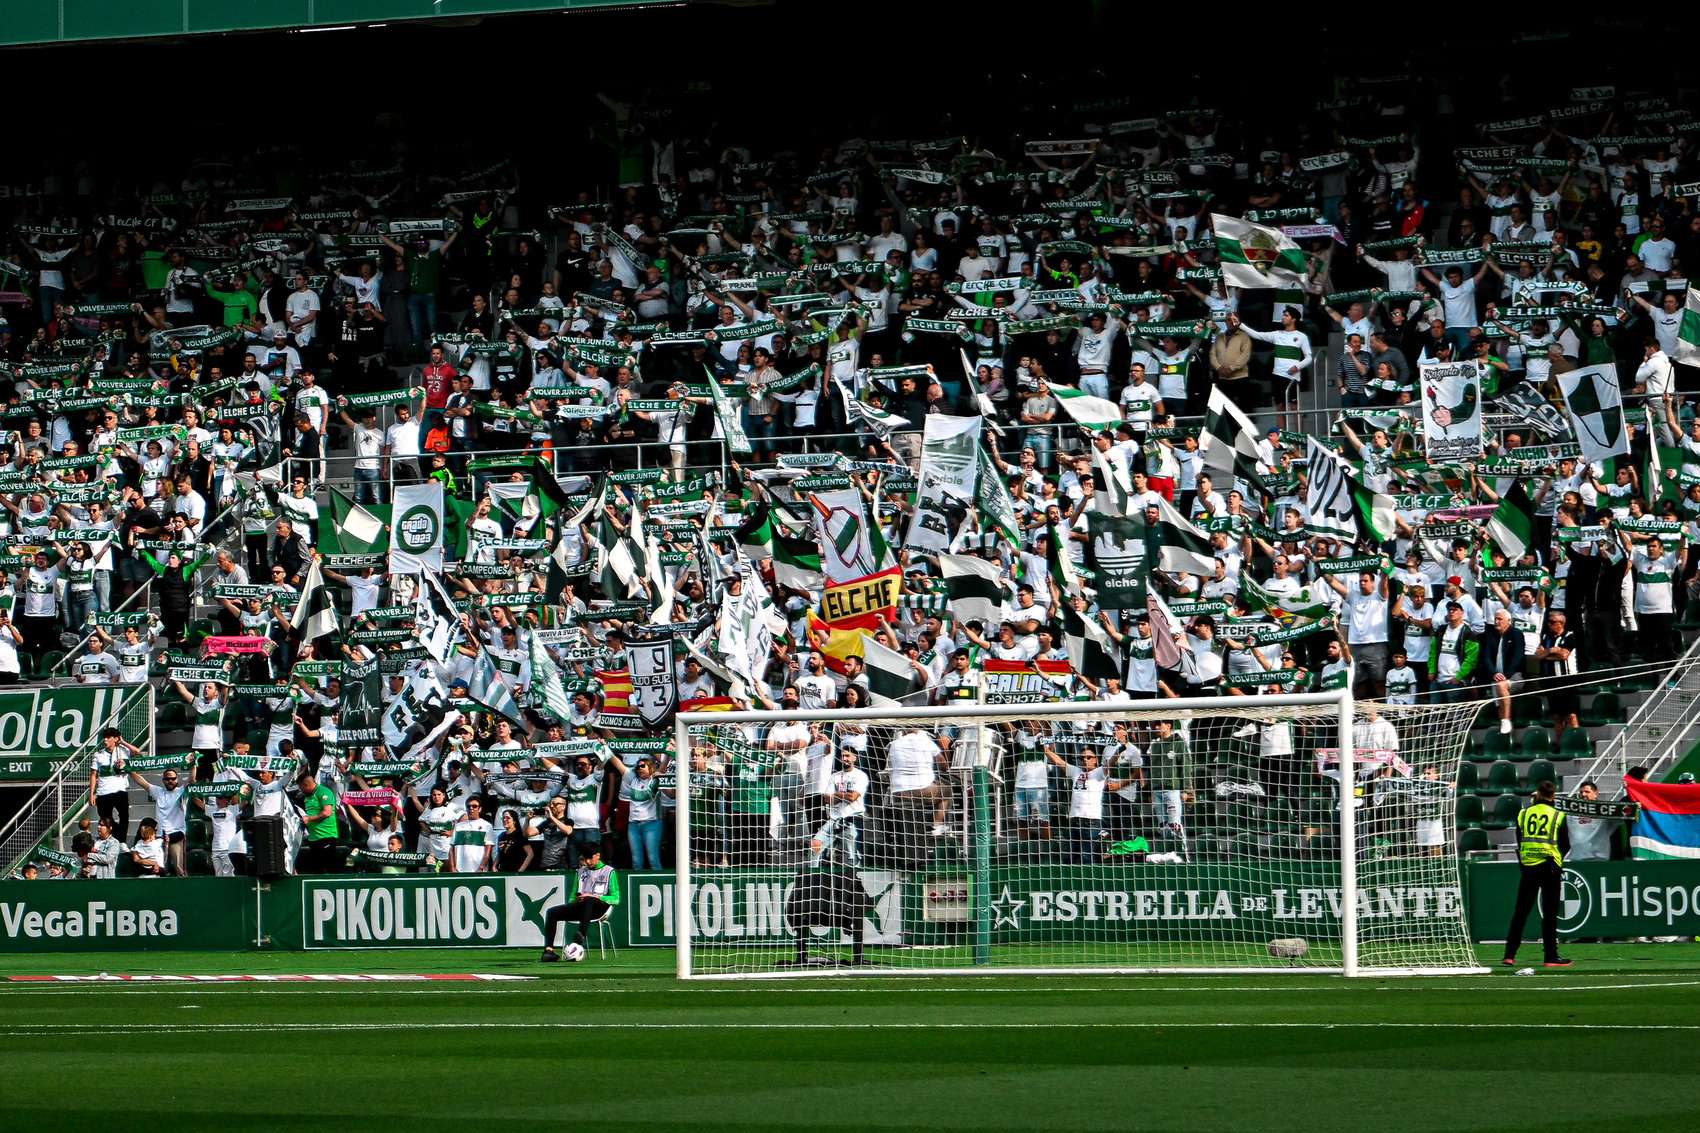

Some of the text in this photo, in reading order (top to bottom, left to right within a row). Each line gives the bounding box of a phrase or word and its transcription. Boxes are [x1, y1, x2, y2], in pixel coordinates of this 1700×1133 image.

[1550, 104, 1587, 117] ELCHE
[1490, 115, 1543, 129] ELCHE CF
[1462, 149, 1517, 158] ELCHE CF
[1516, 158, 1541, 166] VOLVER
[1047, 200, 1102, 209] VOLVER JUNTOS
[1094, 216, 1117, 224] VOLVER
[1365, 237, 1417, 248] VOLVER JUNTOS
[1427, 250, 1481, 262] ELCHE CF
[865, 262, 879, 272] CF
[951, 308, 1005, 316] ELCHE CF
[1506, 307, 1559, 316] ELCHE
[907, 320, 957, 331] ELCHE CF
[1138, 325, 1164, 334] VOLVER
[720, 325, 774, 338] VOLVER JUNTOS
[63, 338, 85, 346] ELCHE
[185, 331, 232, 348] VOLVER JUNTOS
[437, 333, 461, 342] ELCHE
[556, 335, 615, 347] VOLVER JUNTOS
[581, 350, 624, 365] ELCHE CF
[26, 365, 70, 375] VOLVER JUNTOS
[96, 381, 121, 389] VOLVER
[768, 376, 791, 389] VOLVER
[36, 388, 79, 398] ELCHE CF
[534, 388, 587, 396] VOLVER JUNTOS
[61, 397, 109, 408] VOLVER JUNTOS
[134, 395, 176, 405] ELCHE CF
[350, 391, 407, 404] VOLVER JUNTOS
[664, 401, 677, 409] CF
[223, 407, 248, 417] ELCHE
[42, 456, 95, 466] VOLVER JUNTOS
[1478, 465, 1537, 474] ELCHE CF
[611, 470, 660, 481] VOLVER JUNTOS
[657, 479, 702, 496] ELCHE CF
[794, 478, 849, 488] VOLVER JUNTOS
[62, 490, 104, 501] ELCHE CF
[1426, 496, 1441, 508] CF
[1210, 518, 1228, 531] CF
[1618, 517, 1682, 529] VOLVER JUNTOS
[58, 530, 103, 540] ELCHE CF
[1418, 526, 1449, 537] ELCHE
[411, 532, 431, 544] 1923
[146, 541, 189, 550] ELCHE CF
[1320, 558, 1380, 569] VOLVER JUNTOS
[462, 565, 508, 574] CAMPEONES
[1485, 569, 1542, 578] VOLVER JUNTOS
[1105, 578, 1137, 588] elche
[224, 587, 256, 595] ELCHE
[491, 594, 532, 604] ELCHE
[828, 579, 893, 619] ELCHE
[1197, 602, 1226, 611] JUNTOS
[99, 614, 142, 625] ELCHE CF
[1259, 623, 1317, 641] VOLVER JUNTOS
[170, 657, 196, 665] VOLVER
[172, 670, 200, 678] ELCHE
[297, 665, 323, 673] ELCHE
[652, 674, 671, 685] SUR
[1230, 672, 1291, 683] VOLVER JUNTOS
[263, 686, 289, 694] JUNTOS
[600, 716, 621, 726] SOMOS
[352, 729, 366, 740] POR
[368, 728, 378, 739] TI
[635, 741, 665, 749] JUNTOS
[470, 749, 530, 758] VOLVER JUNTOS
[9, 762, 32, 772] EXIT
[129, 756, 183, 768] VOLVER JUNTOS
[354, 763, 411, 771] VOLVER JUNTOS
[187, 784, 239, 794] VOLVER JUNTOS
[1555, 800, 1616, 816] ELCHE CF
[1527, 812, 1548, 837] 62
[38, 847, 60, 861] VOLVER
[1029, 888, 1461, 921] ESTRELLA DE LEVANTE
[312, 886, 498, 940] PIKOLINOS
